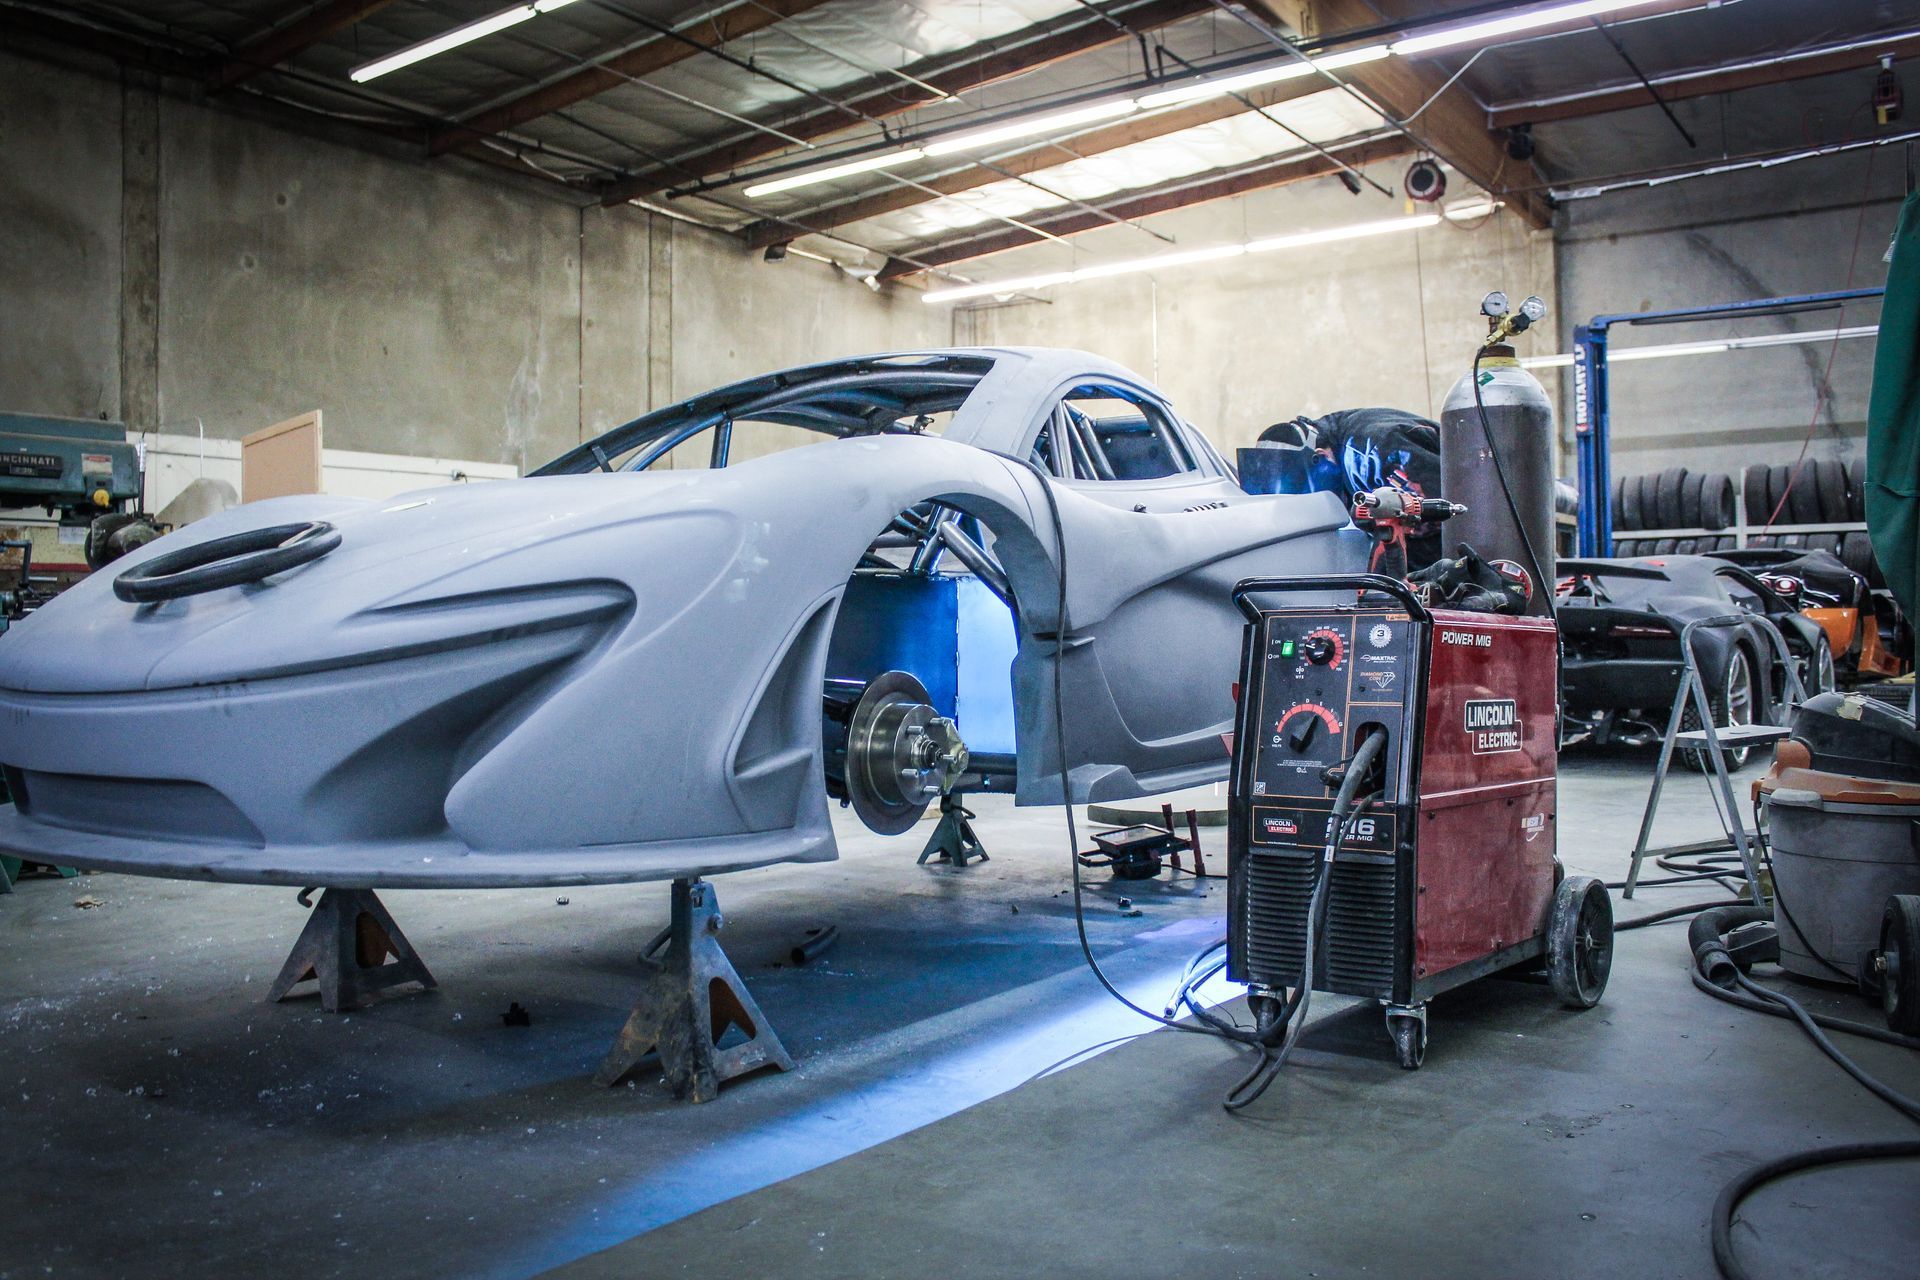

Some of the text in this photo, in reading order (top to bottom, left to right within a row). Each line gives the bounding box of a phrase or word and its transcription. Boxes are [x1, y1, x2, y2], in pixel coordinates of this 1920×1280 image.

[1441, 631, 1491, 647] POWER MIG
[1467, 705, 1513, 727] LINCOLN
[1478, 731, 1518, 749] ELECTRIC
[1264, 819, 1292, 827] LINCOLN
